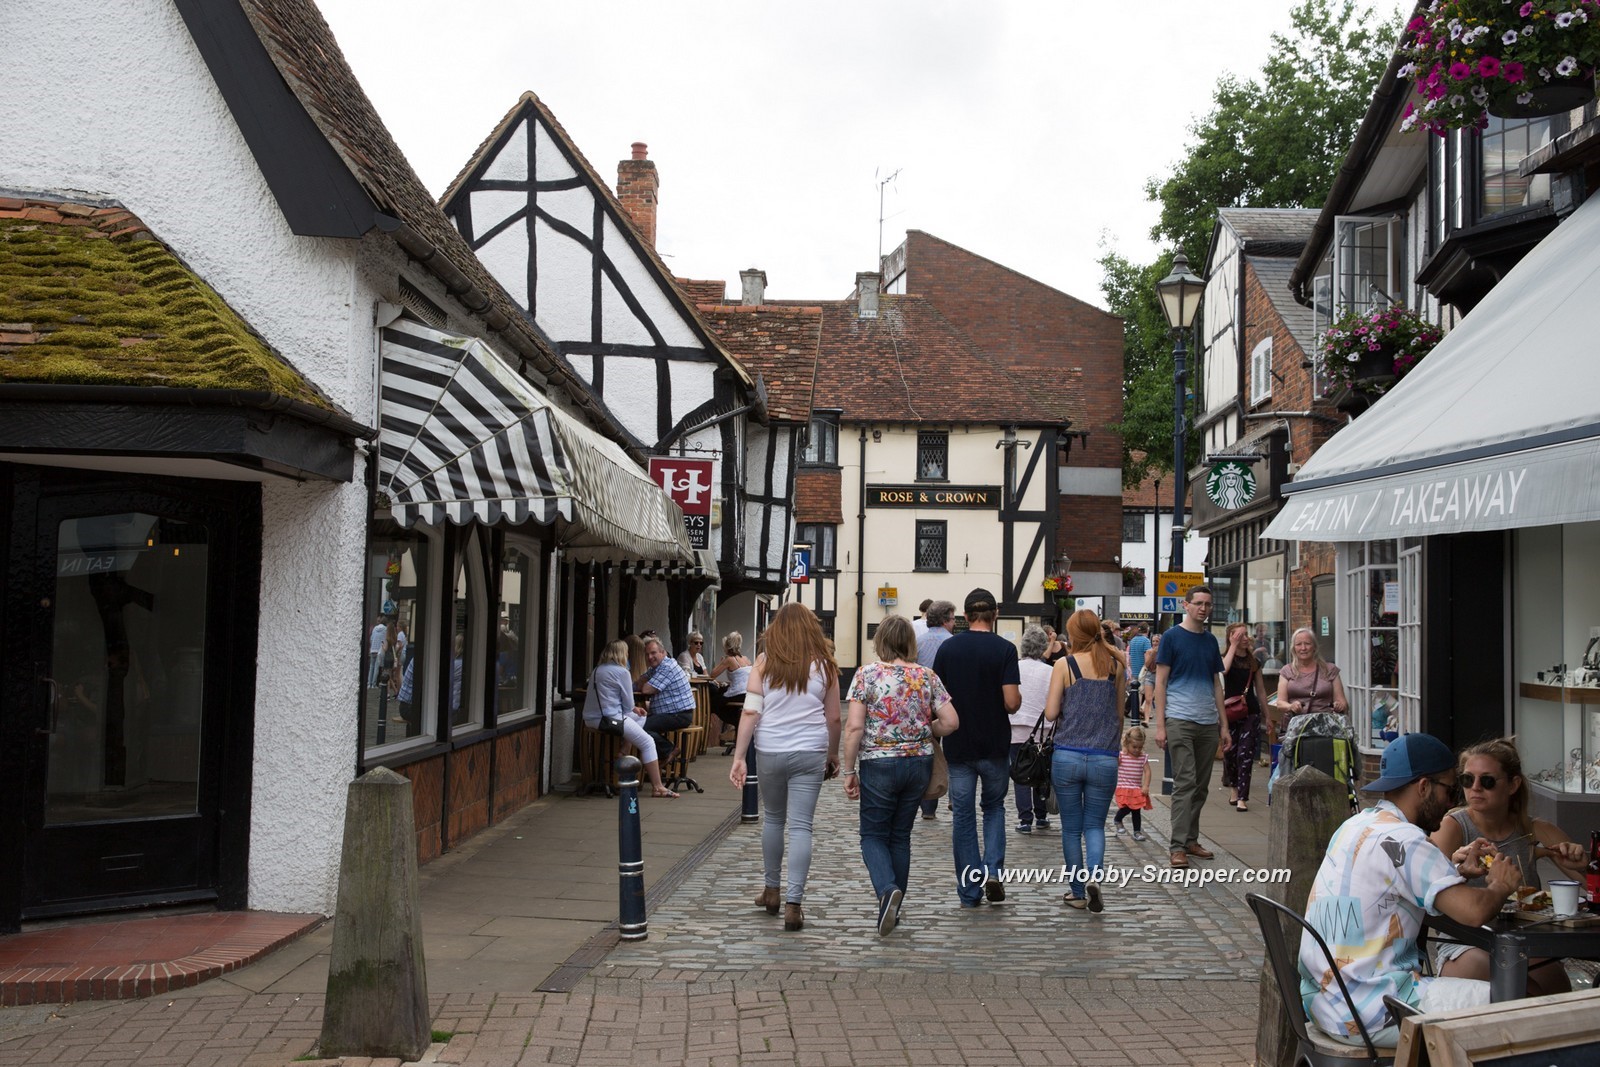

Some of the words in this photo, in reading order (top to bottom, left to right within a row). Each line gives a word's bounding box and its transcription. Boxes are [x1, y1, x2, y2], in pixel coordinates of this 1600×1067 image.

[880, 491, 914, 502] ROSE
[919, 492, 929, 503] &
[935, 492, 987, 503] CROWN
[1389, 468, 1527, 526] TAKEAWAY
